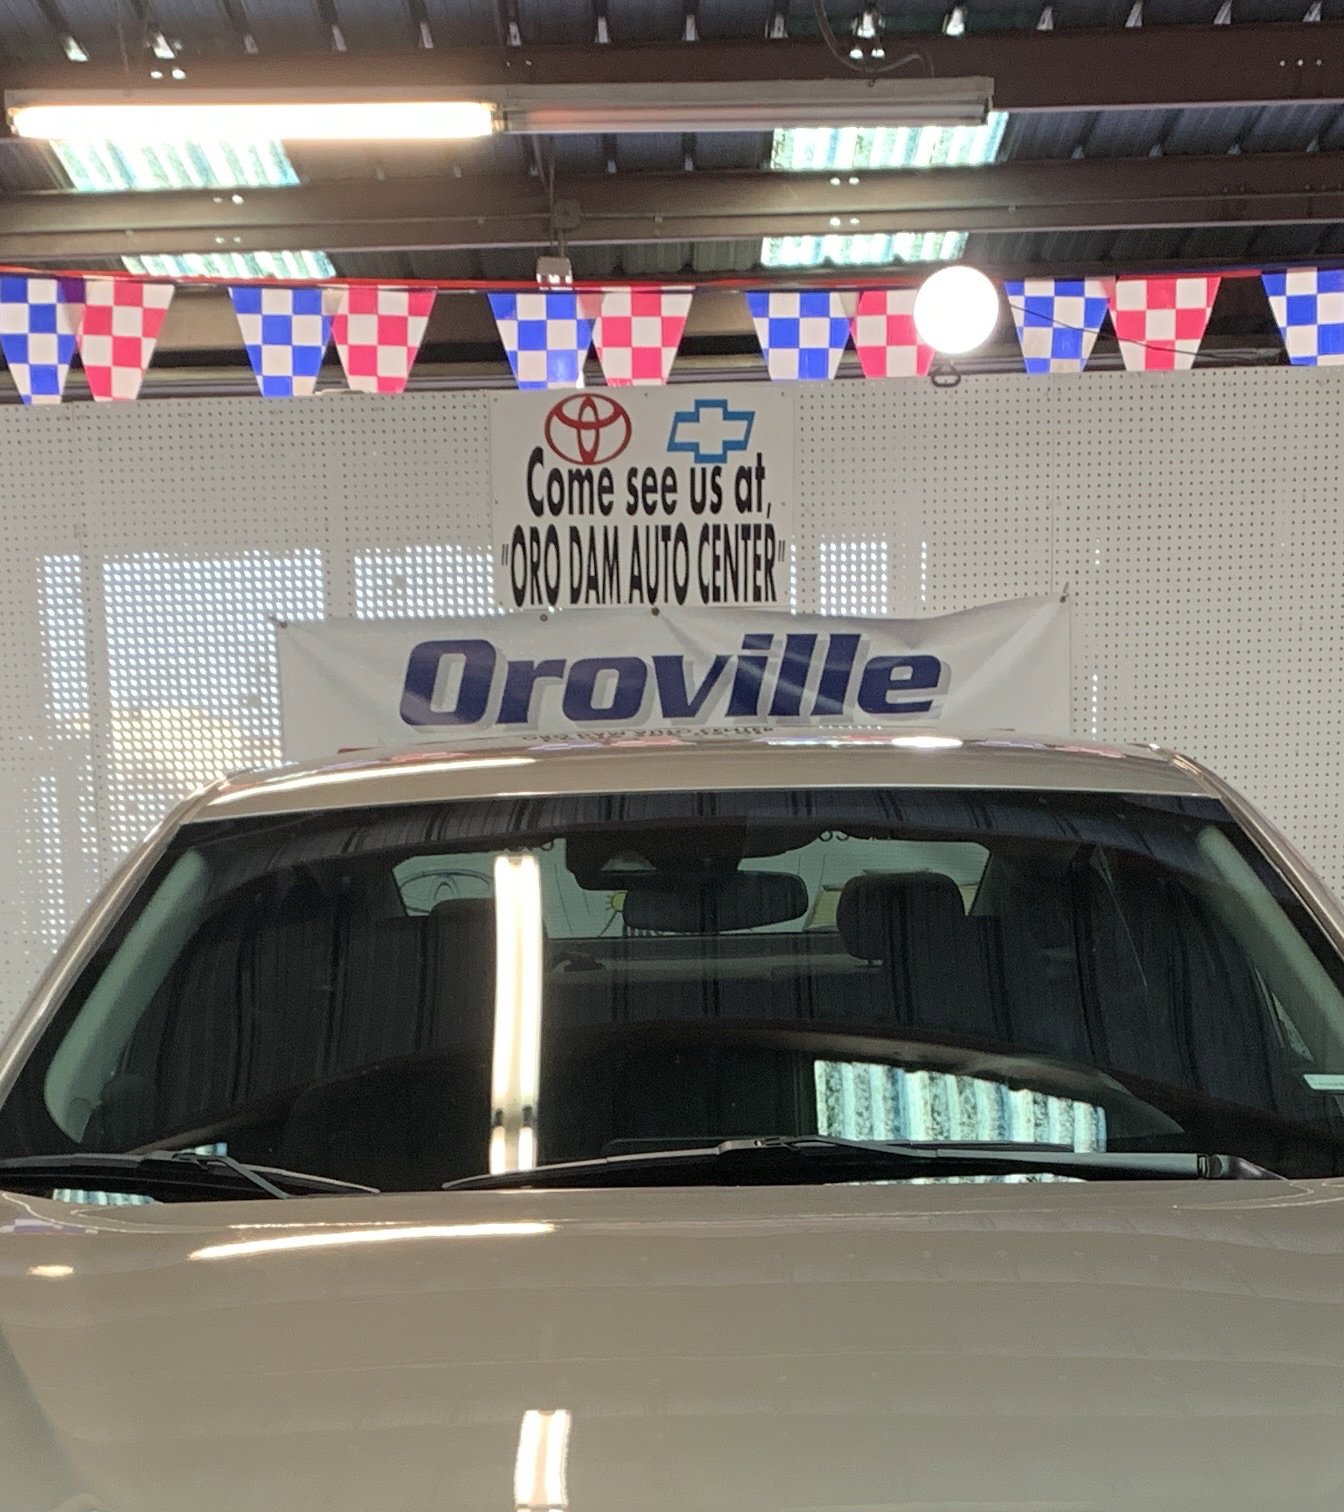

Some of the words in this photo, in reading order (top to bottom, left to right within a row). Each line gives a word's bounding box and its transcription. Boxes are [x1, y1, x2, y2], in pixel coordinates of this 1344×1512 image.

[526, 446, 615, 517] Come
[626, 466, 678, 516] see
[690, 465, 723, 515] us
[735, 452, 771, 520] at,
[502, 524, 561, 607] "ORO
[569, 525, 621, 604] DAM
[629, 522, 690, 606] AUTO
[698, 522, 785, 604] CENTER"
[399, 633, 944, 728] Oroville
